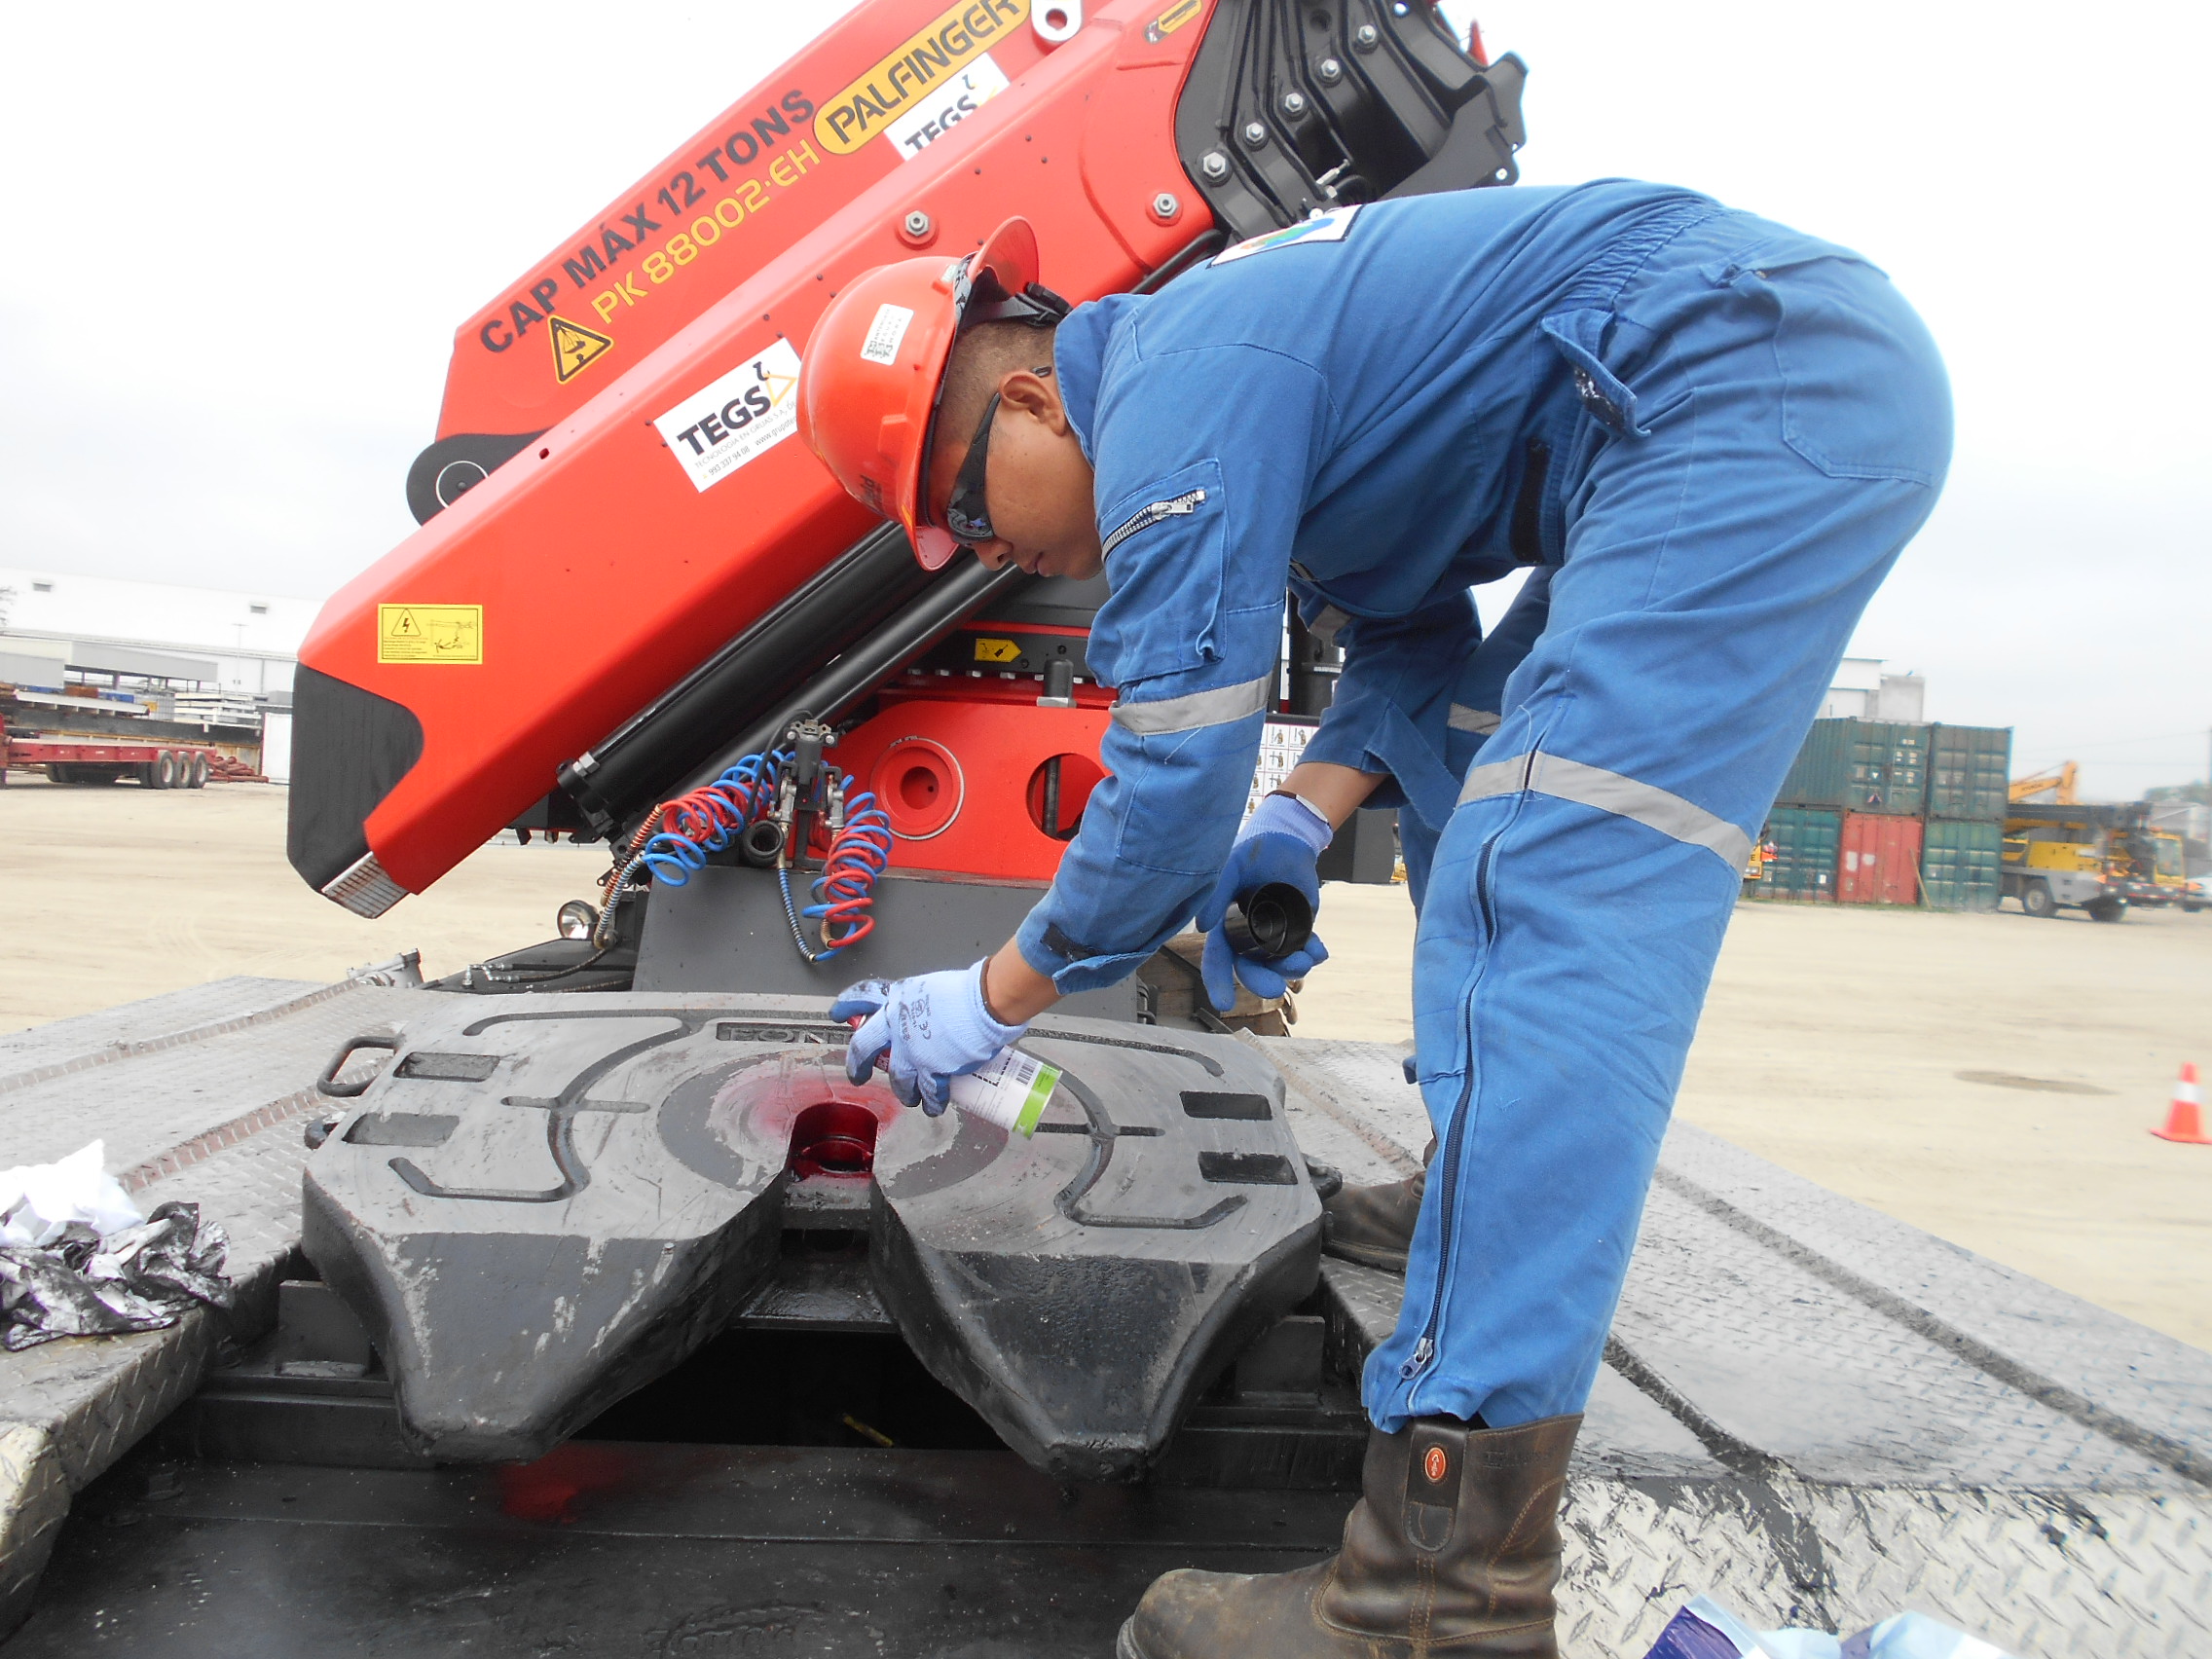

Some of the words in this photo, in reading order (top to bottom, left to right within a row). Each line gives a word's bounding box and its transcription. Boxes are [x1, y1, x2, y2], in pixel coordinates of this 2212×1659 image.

[826, 0, 1020, 145] PALFINGER
[479, 278, 559, 352] CAP
[561, 203, 662, 289] MÁX
[657, 171, 707, 217] 12
[695, 90, 815, 183] TONS
[591, 271, 649, 325] PK
[676, 385, 771, 457] TEGS
